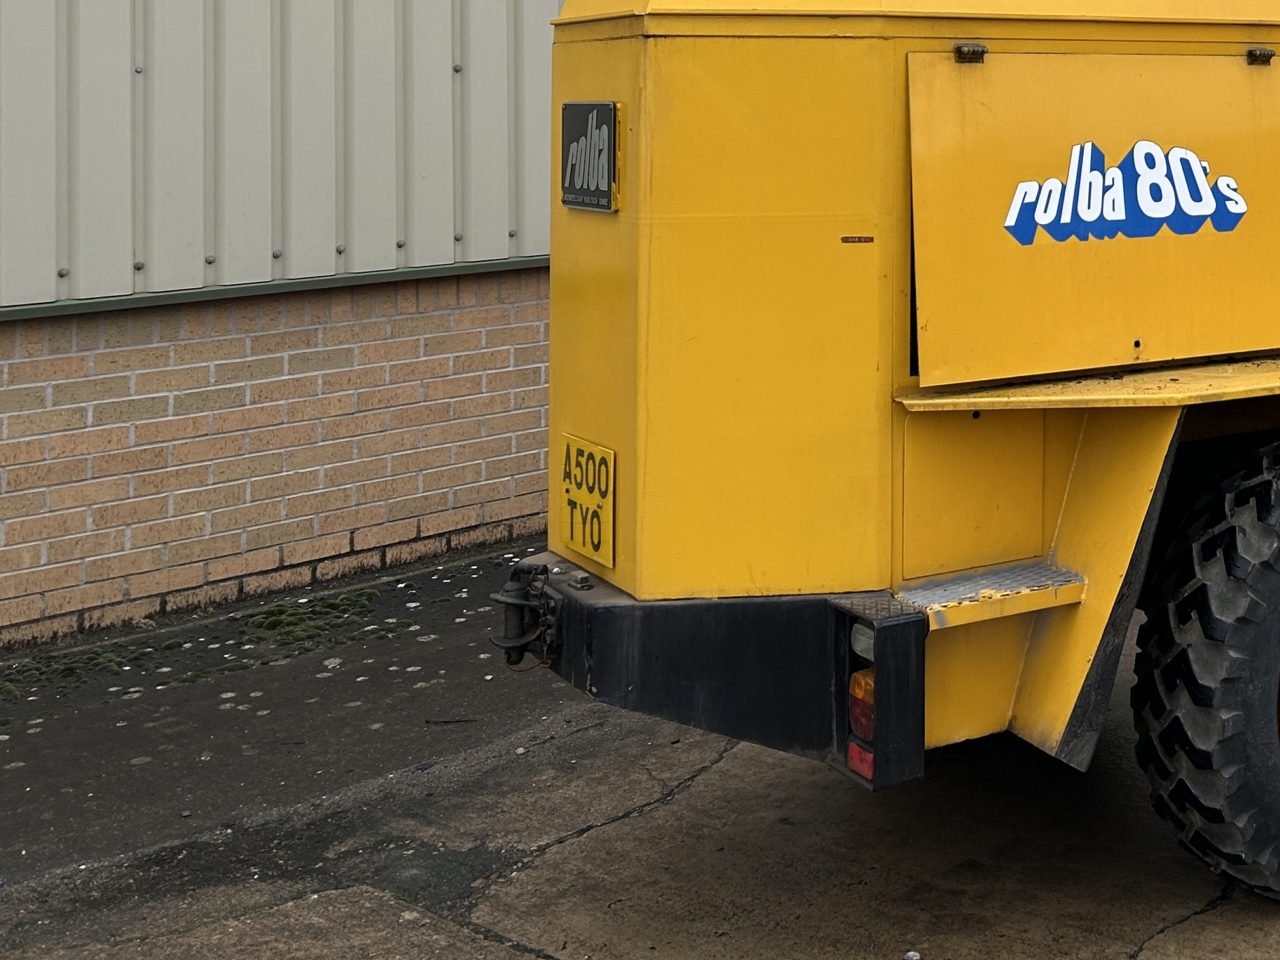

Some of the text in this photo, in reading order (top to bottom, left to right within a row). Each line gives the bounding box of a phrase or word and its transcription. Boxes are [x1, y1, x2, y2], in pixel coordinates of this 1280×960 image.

[564, 108, 609, 192] rolba
[1003, 140, 1127, 230] rolba
[562, 441, 609, 500] A500
[567, 497, 602, 553] TYO
